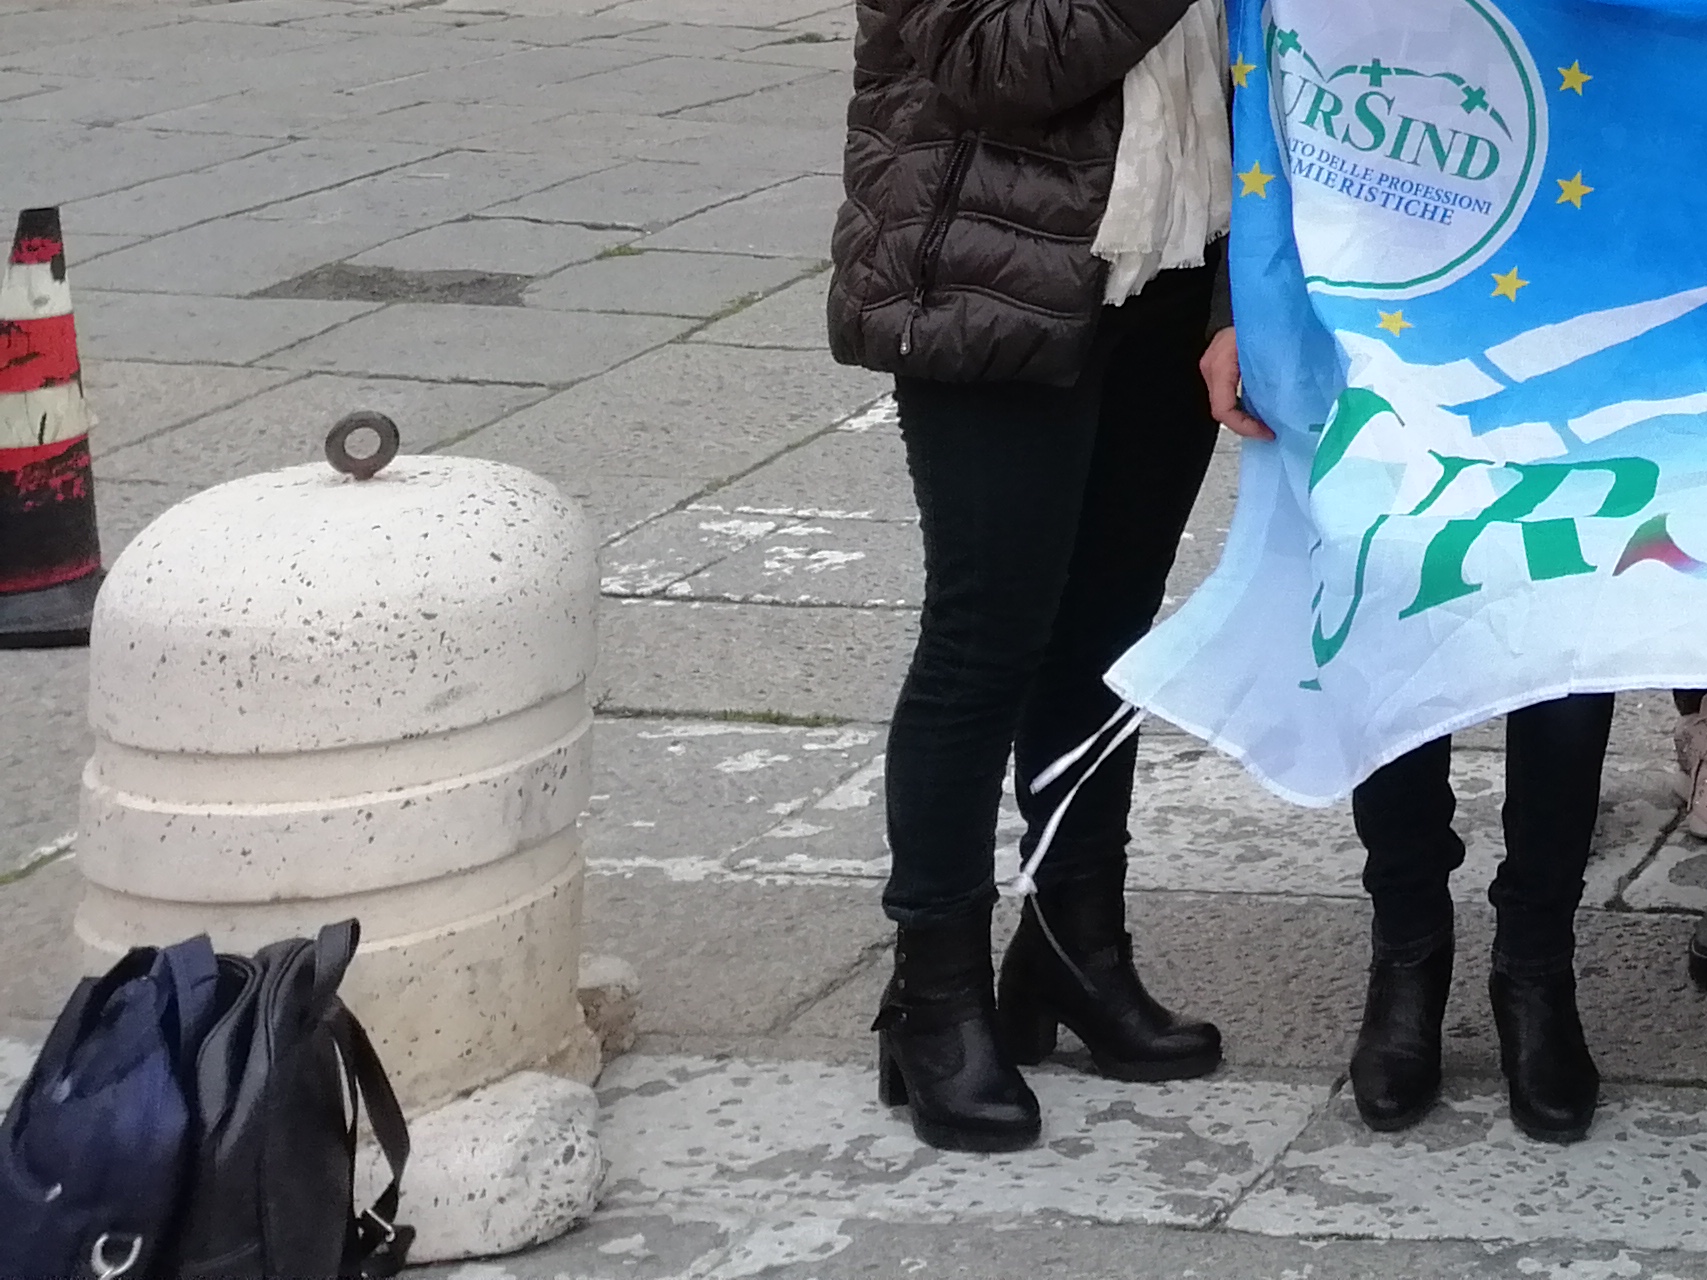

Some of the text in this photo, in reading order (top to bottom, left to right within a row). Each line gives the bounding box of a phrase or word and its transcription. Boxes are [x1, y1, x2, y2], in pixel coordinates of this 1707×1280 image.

[1280, 69, 1500, 182] URSIND
[1289, 158, 1455, 227] MIERISTICHE
[1316, 148, 1375, 182] DELLE
[1372, 172, 1493, 217] PROFESSIONI
